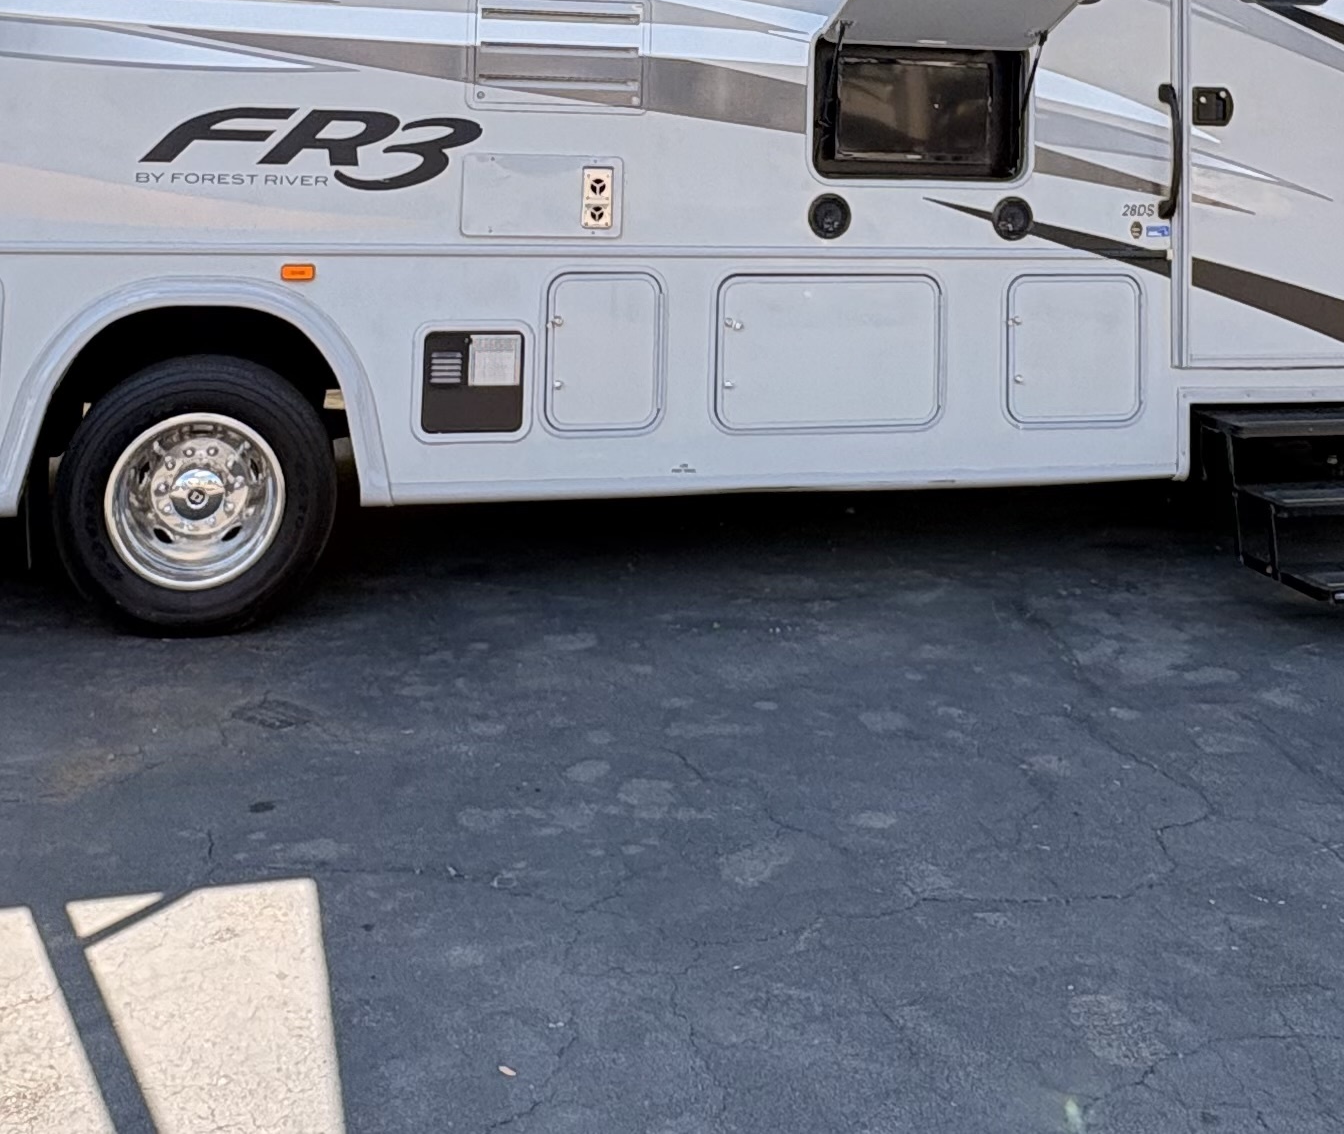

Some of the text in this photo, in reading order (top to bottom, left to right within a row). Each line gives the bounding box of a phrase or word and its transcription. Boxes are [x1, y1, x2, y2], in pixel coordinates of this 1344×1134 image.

[138, 107, 483, 191] FR3
[136, 172, 328, 187] BY FOREST RIVER
[1121, 203, 1155, 217] 28DS
